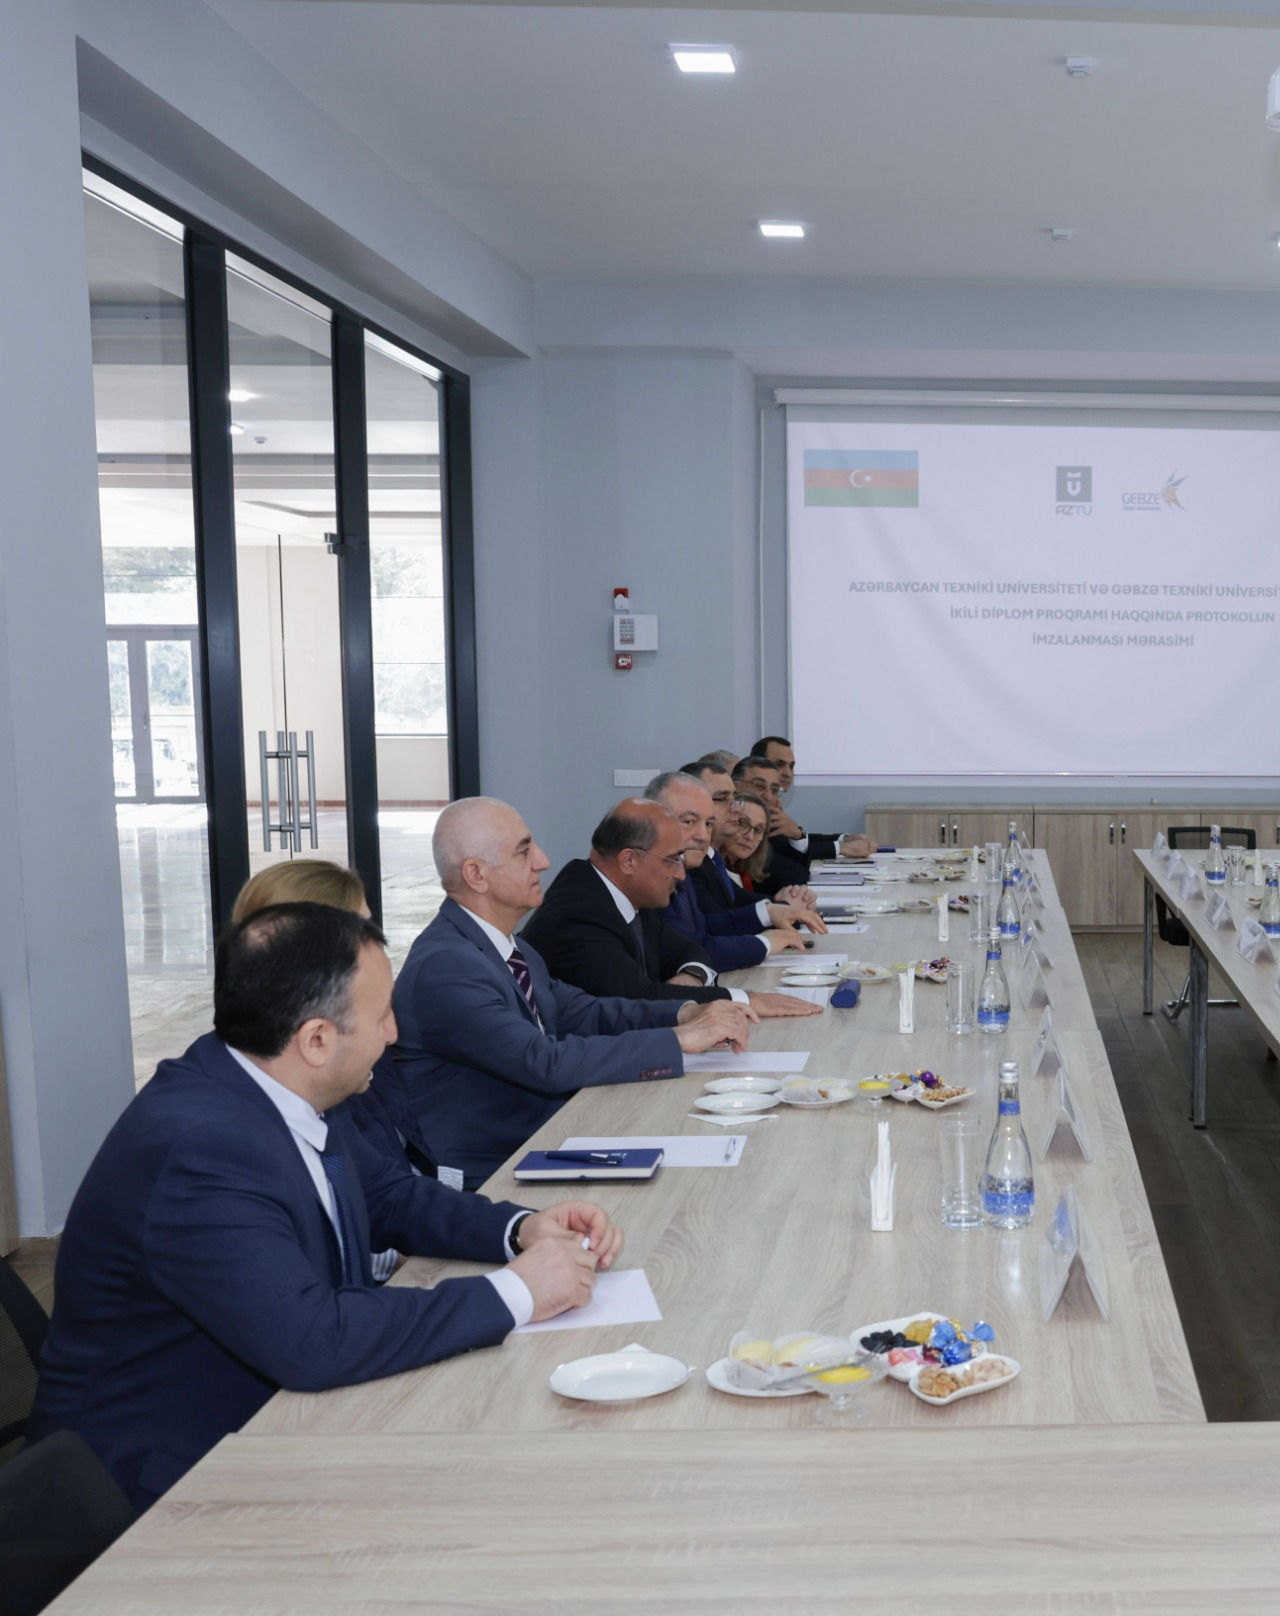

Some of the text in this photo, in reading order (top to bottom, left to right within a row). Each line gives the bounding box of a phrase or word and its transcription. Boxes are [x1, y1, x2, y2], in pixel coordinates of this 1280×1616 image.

[1122, 492, 1161, 505] GEBZE
[849, 581, 939, 593] AZƏRBAYCAN
[943, 581, 994, 594] TEXNİKİ
[997, 580, 1087, 594] UNİVERSİTETİ
[1089, 584, 1109, 595] VƏ
[1111, 584, 1160, 596] GƏBZƏ
[1162, 583, 1213, 596] TEXNİKİ
[950, 606, 1275, 624] İKİLİ DİPLOM PROQRAMI HAQQINDA PROTOKOLUN
[1032, 632, 1194, 647] İMZALANMASI MƏRASİMİ
